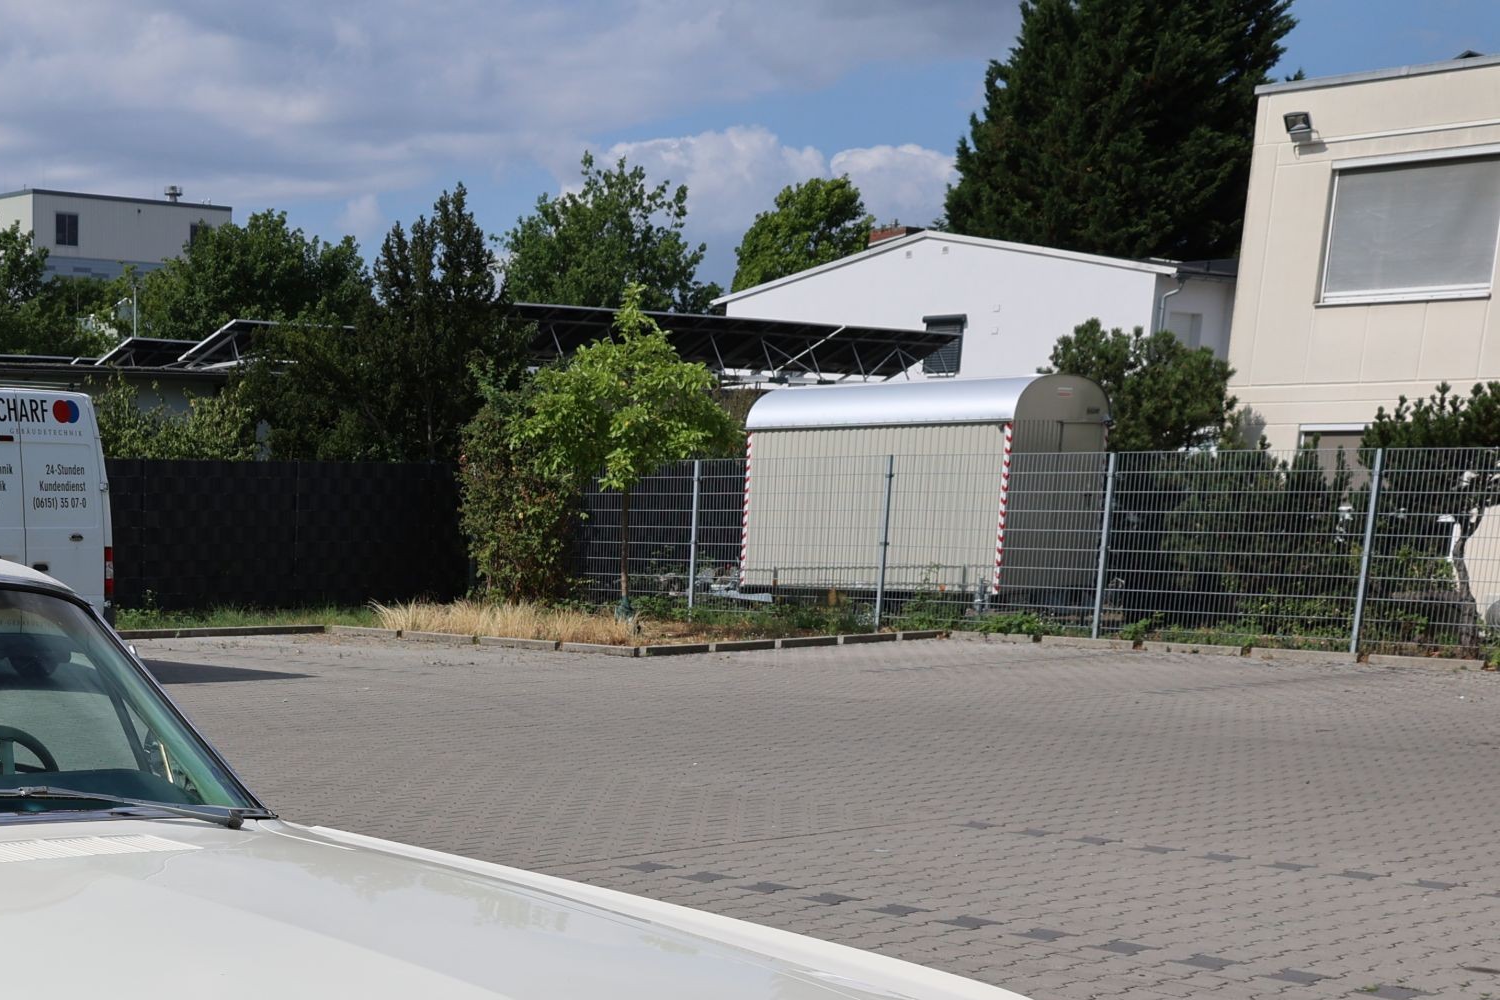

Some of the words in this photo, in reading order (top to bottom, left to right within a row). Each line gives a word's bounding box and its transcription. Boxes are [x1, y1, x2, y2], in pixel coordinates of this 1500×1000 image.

[45, 464, 85, 475] 24-Stunden
[39, 480, 86, 492] Kundendienst
[33, 496, 58, 510] (06151)
[60, 497, 69, 508] 35
[70, 497, 87, 508] 07-0
